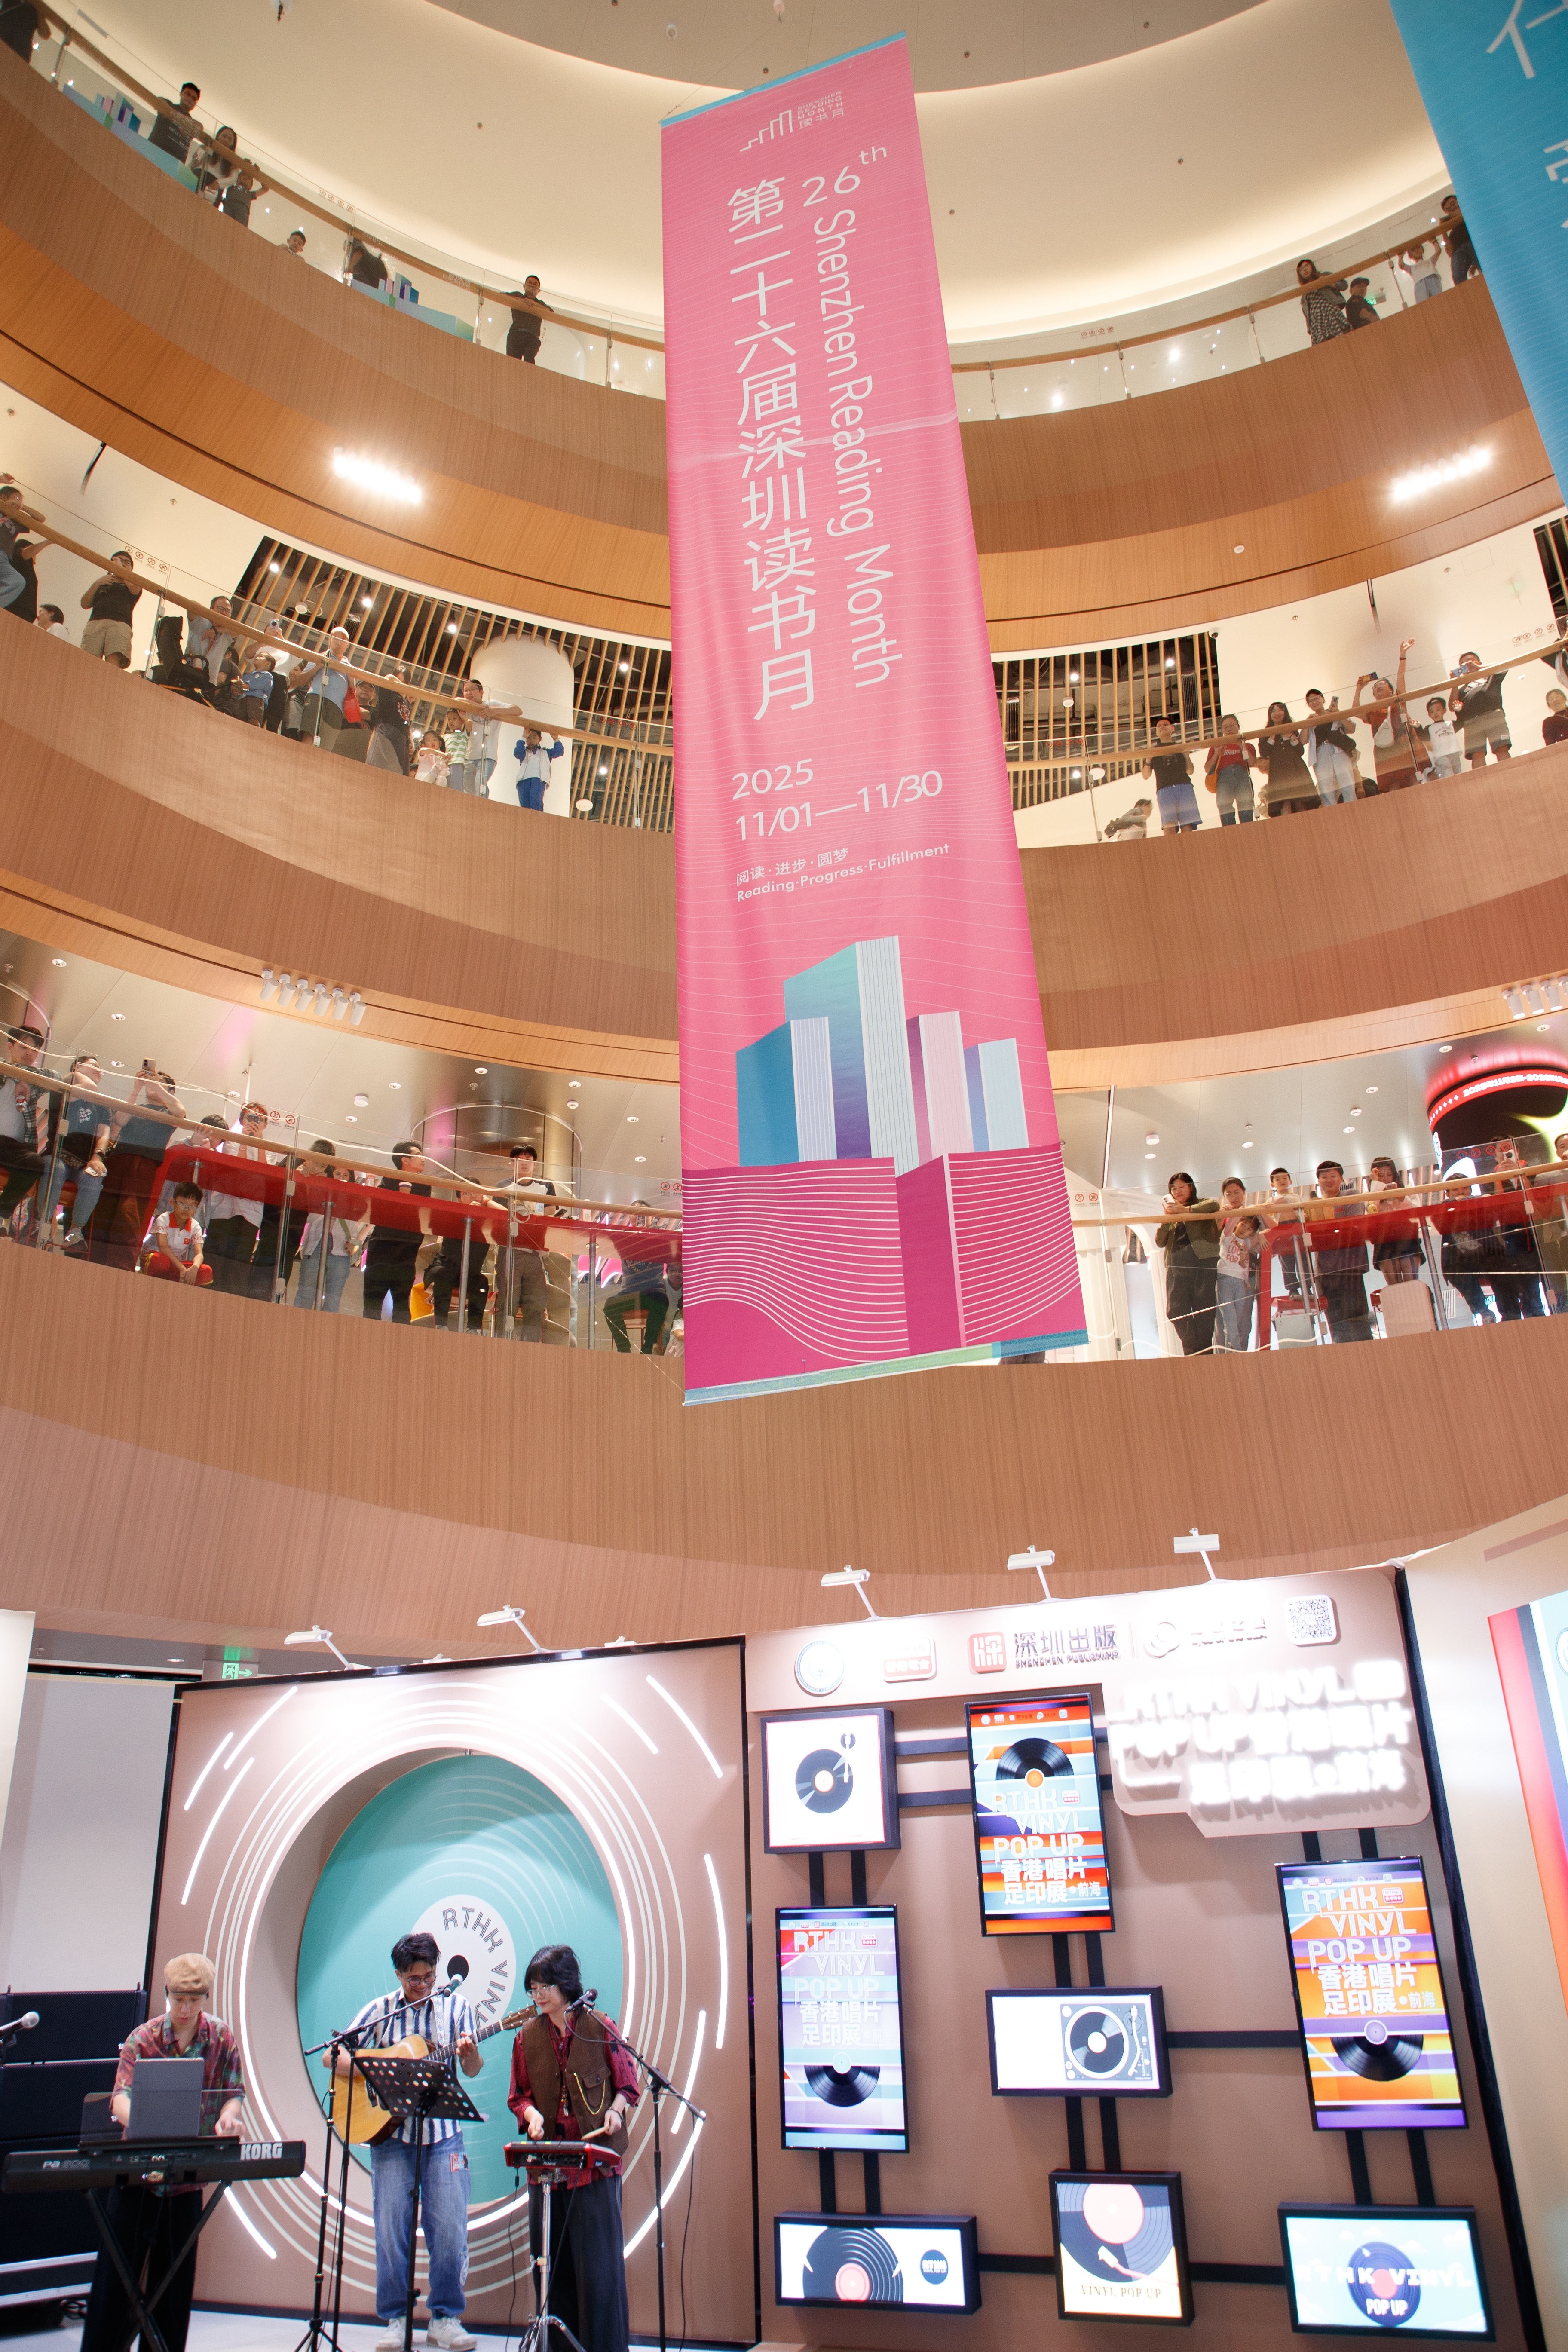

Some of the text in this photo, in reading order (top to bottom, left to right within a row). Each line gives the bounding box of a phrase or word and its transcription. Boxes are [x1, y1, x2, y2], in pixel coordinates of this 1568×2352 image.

[798, 90, 841, 110] SHENZHEN
[798, 95, 842, 115] READING
[798, 102, 842, 120] MONTH
[799, 108, 844, 129] 读书月
[813, 209, 865, 377] Shenzhen
[727, 176, 817, 720] 第二十六届深圳读书月
[826, 374, 882, 537] Reading
[844, 543, 902, 688] Month
[732, 758, 814, 801] 2025
[1014, 1624, 1117, 1658] 深圳出版
[1016, 1650, 1120, 1669] SHENZHEN PUBLISHING
[1230, 1667, 1356, 1710] VINYL
[991, 1788, 1058, 1813] RTHK
[1015, 1809, 1089, 1835] VINYL
[993, 1833, 1084, 1862] POP UP
[1001, 1856, 1087, 1883] 香港唱片
[1302, 1886, 1378, 1913] RTHK
[1329, 1910, 1417, 1938] VINYL
[794, 1930, 857, 1952] RTHK
[1308, 1936, 1412, 1964] POP UP
[442, 1906, 508, 2028] RTHK VINY
[814, 1954, 885, 1976] VINYL
[1317, 1961, 1417, 1991] 香港唱片
[794, 1977, 879, 2001] POP UP
[800, 2000, 881, 2024] 香港唱片
[240, 2143, 282, 2160] KORG
[1295, 2263, 1473, 2287] RTHK VINYL
[1081, 2285, 1161, 2299] VINYL POP UP
[1366, 2298, 1408, 2316] POP UP
